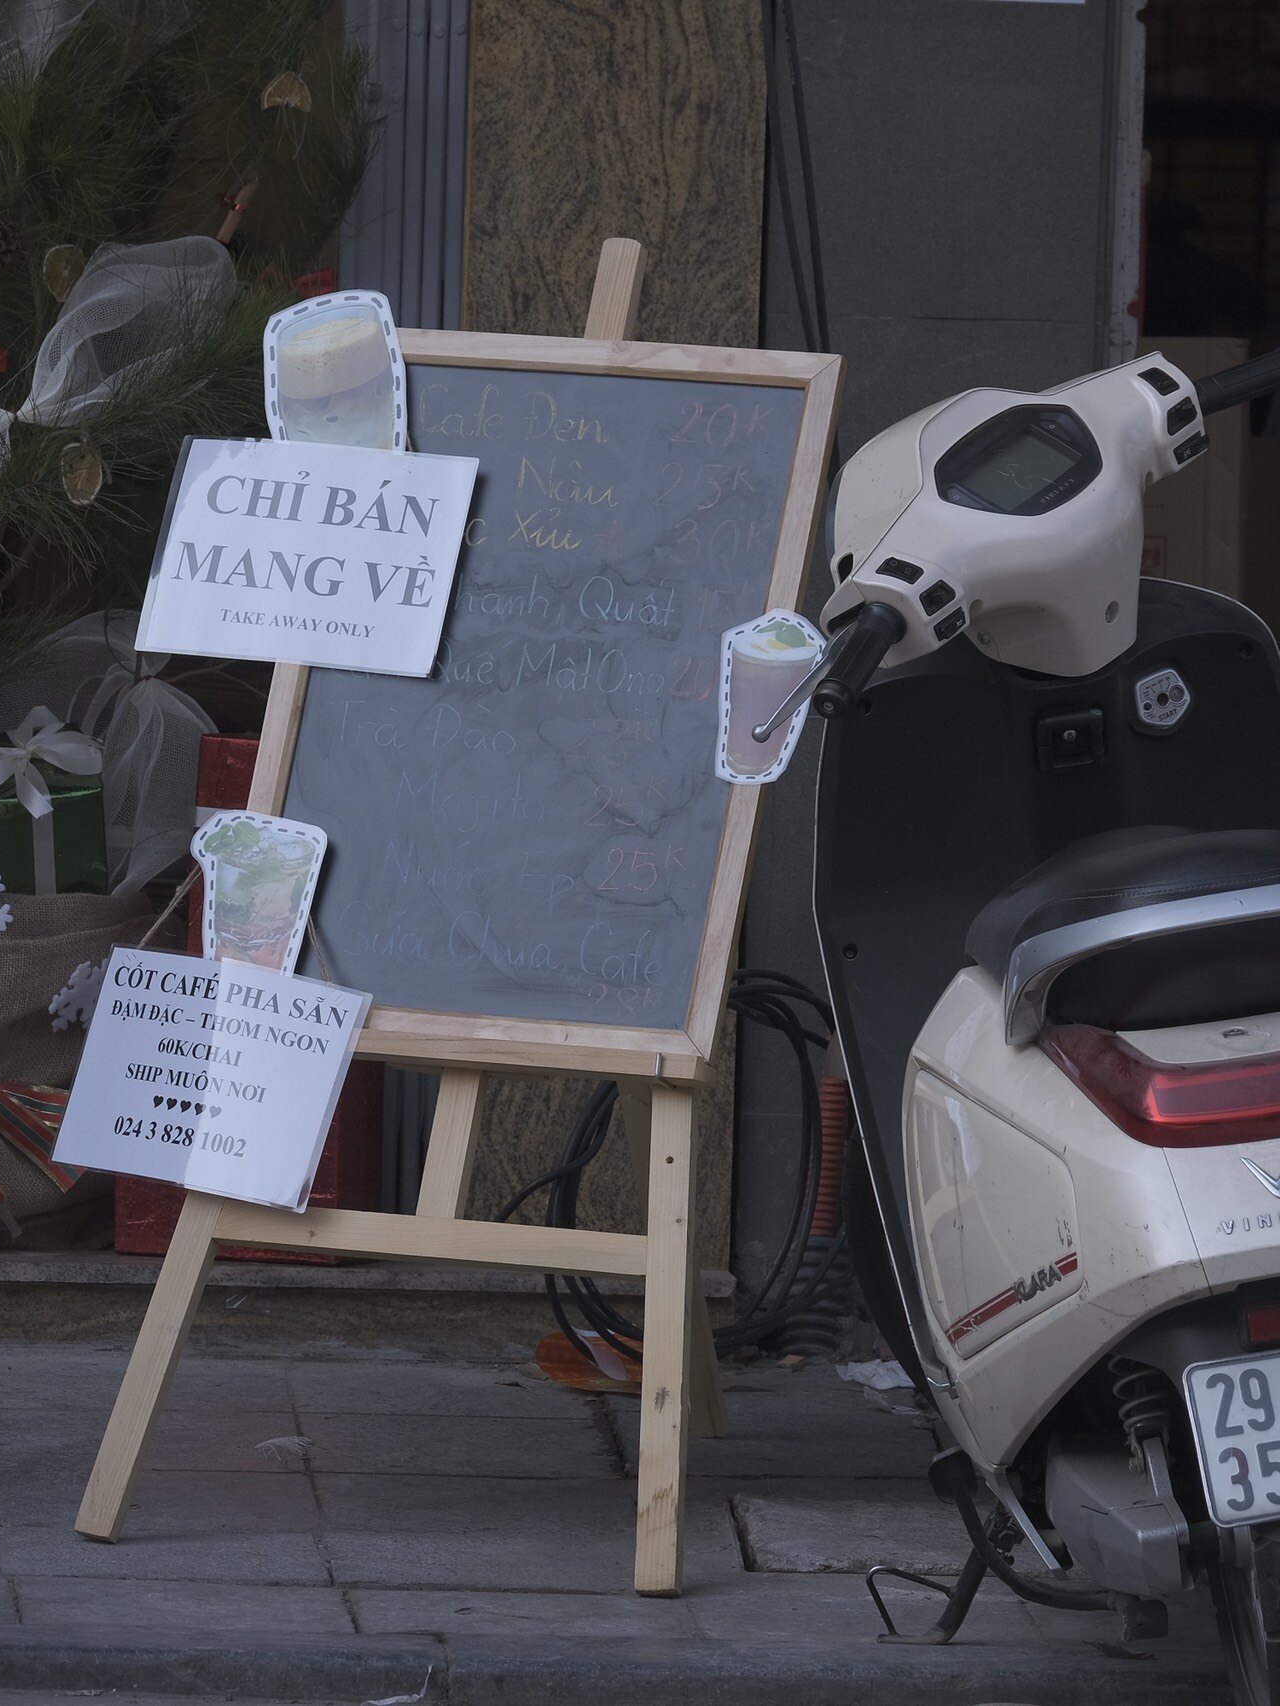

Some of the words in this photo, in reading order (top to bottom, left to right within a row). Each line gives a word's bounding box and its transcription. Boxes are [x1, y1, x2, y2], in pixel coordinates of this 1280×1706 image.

[206, 470, 311, 523] CHỈ
[317, 479, 441, 538] BÁN
[170, 540, 346, 598] MANG
[363, 554, 437, 609] VỀ
[219, 607, 266, 627] TAKE
[268, 614, 323, 633] AWAY
[325, 619, 376, 639] ONLY
[597, 843, 688, 893] 25K
[114, 961, 159, 991] CỐT
[160, 972, 220, 1001] CAFÉ
[223, 981, 281, 1015] PHA
[110, 998, 147, 1021] ĐẬM
[148, 1003, 184, 1027] ĐẶC
[200, 1011, 262, 1040] THƠM
[264, 1025, 331, 1055] NGON
[157, 1036, 243, 1068] 60K/CHAI
[125, 1062, 163, 1083] SHIP
[165, 1069, 225, 1095] MUÔN
[226, 1080, 268, 1104] NƠI
[113, 1115, 144, 1138] 024
[145, 1120, 158, 1140] 3
[160, 1123, 195, 1147] 828
[200, 1130, 248, 1158] 1002
[1220, 1211, 1280, 1236] VIN
[1205, 1368, 1276, 1439] 29
[1218, 1440, 1280, 1512] 35
